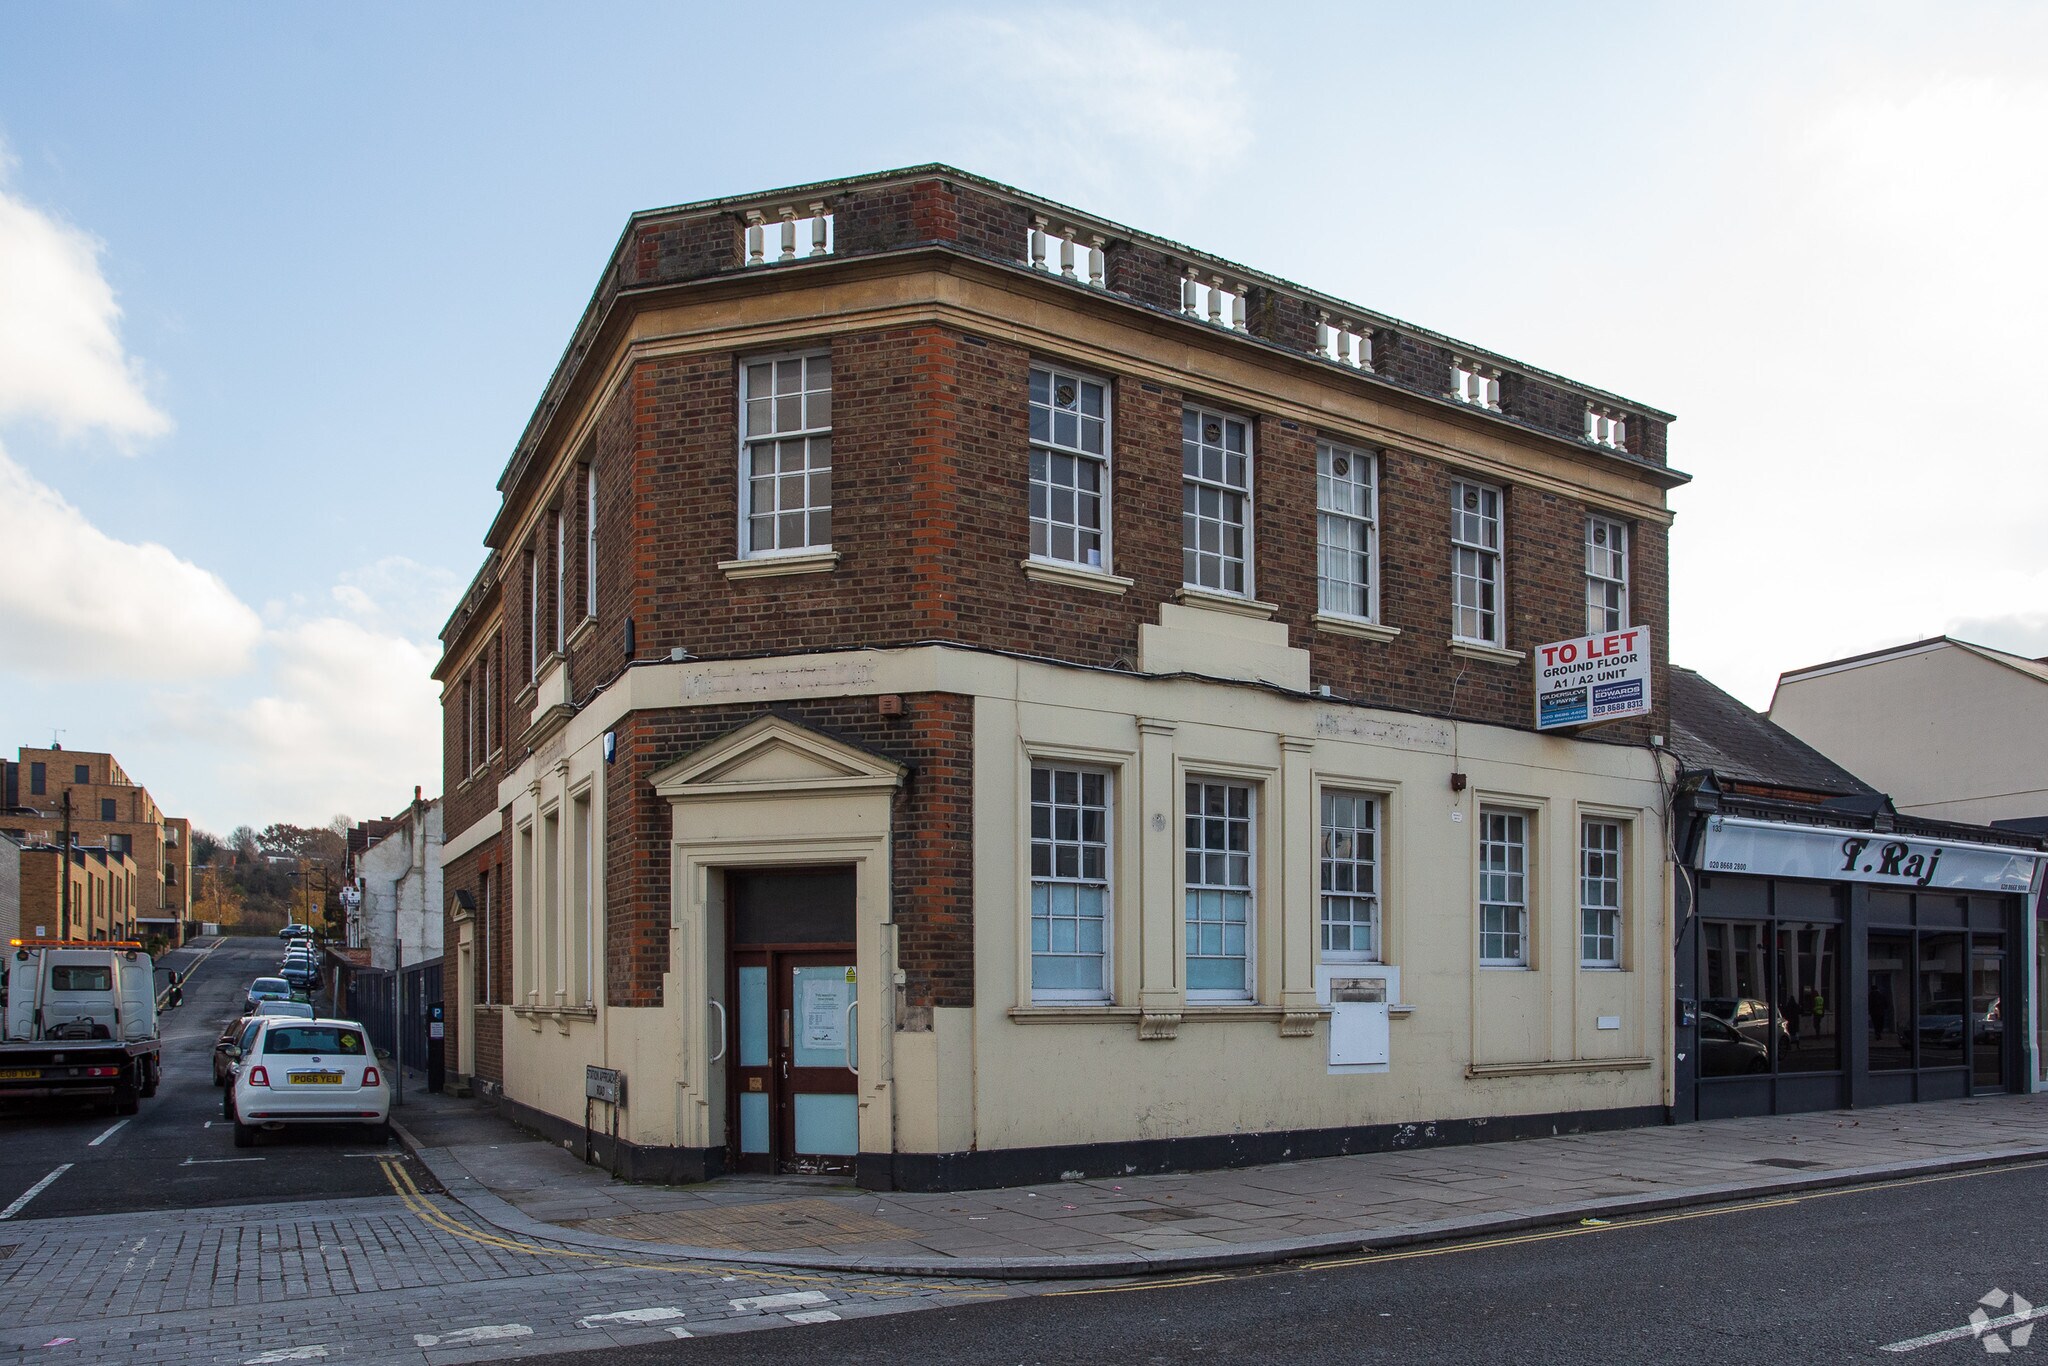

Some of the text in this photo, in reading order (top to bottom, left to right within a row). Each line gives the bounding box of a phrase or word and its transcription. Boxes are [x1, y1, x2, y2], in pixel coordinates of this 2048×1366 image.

[1542, 632, 1638, 666] TO LET
[1544, 653, 1638, 678] GROUND FLOOR
[1554, 679, 1568, 689] A1
[1579, 674, 1594, 685] A2
[1597, 668, 1627, 682] UNIT
[1541, 689, 1586, 700] GILDERSLEVE
[1595, 686, 1640, 699] EDWARDS
[1556, 696, 1578, 705] PAYNE
[1593, 706, 1605, 714] 020
[1607, 702, 1625, 712] 8688
[1627, 699, 1643, 709] 8313
[1713, 825, 1722, 833] 133
[1709, 861, 1719, 869] 020
[1720, 861, 1733, 870] 8668
[434, 1008, 441, 1018] P
[294, 1074, 338, 1083] PO66 YEU
